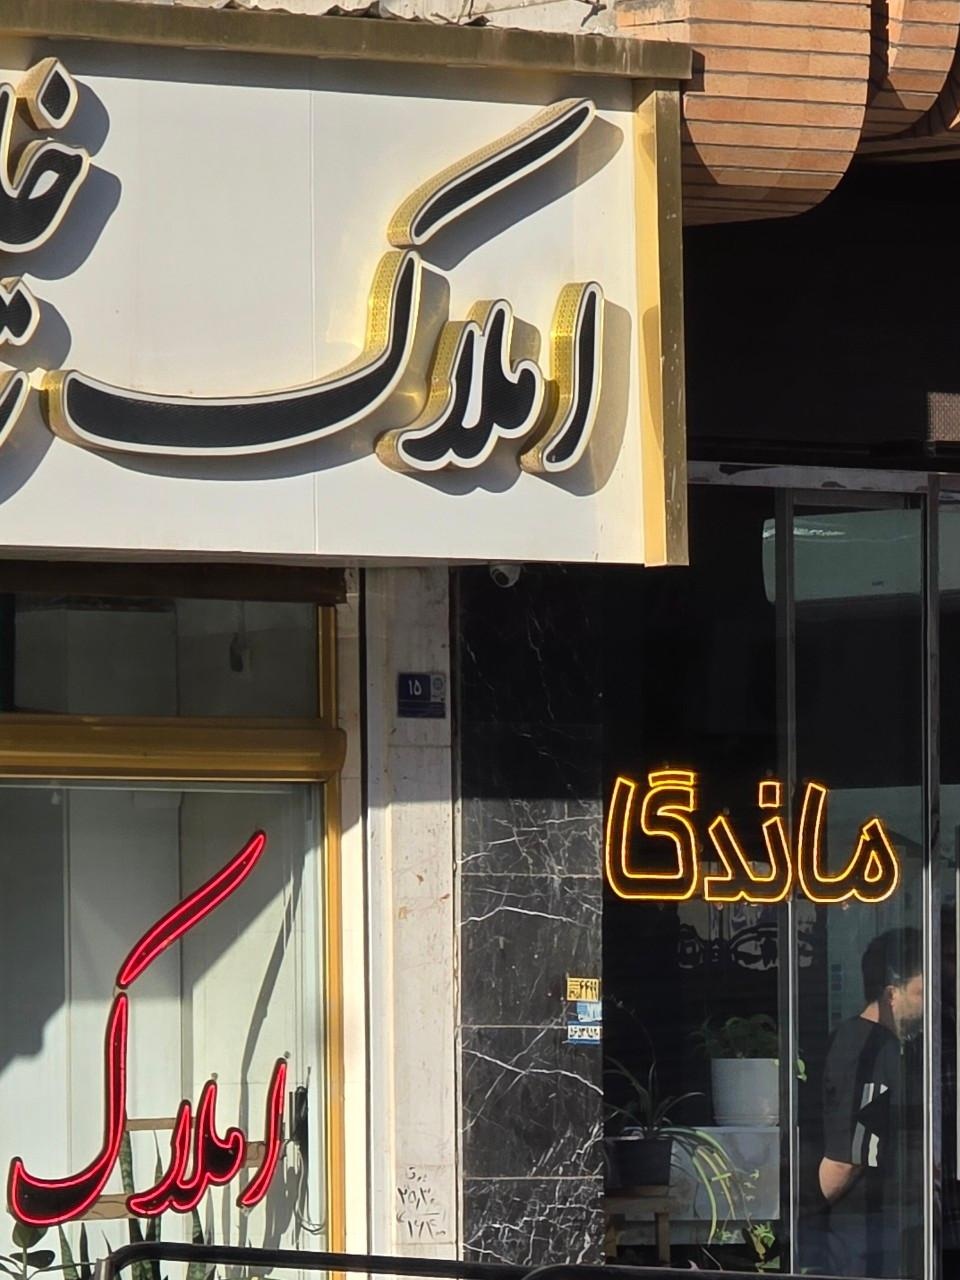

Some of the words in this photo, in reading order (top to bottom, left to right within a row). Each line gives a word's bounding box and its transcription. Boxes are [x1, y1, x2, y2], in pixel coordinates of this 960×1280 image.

[42, 98, 603, 473] املاک
[408, 679, 422, 696] ۱۵
[9, 830, 288, 1226] املاک
